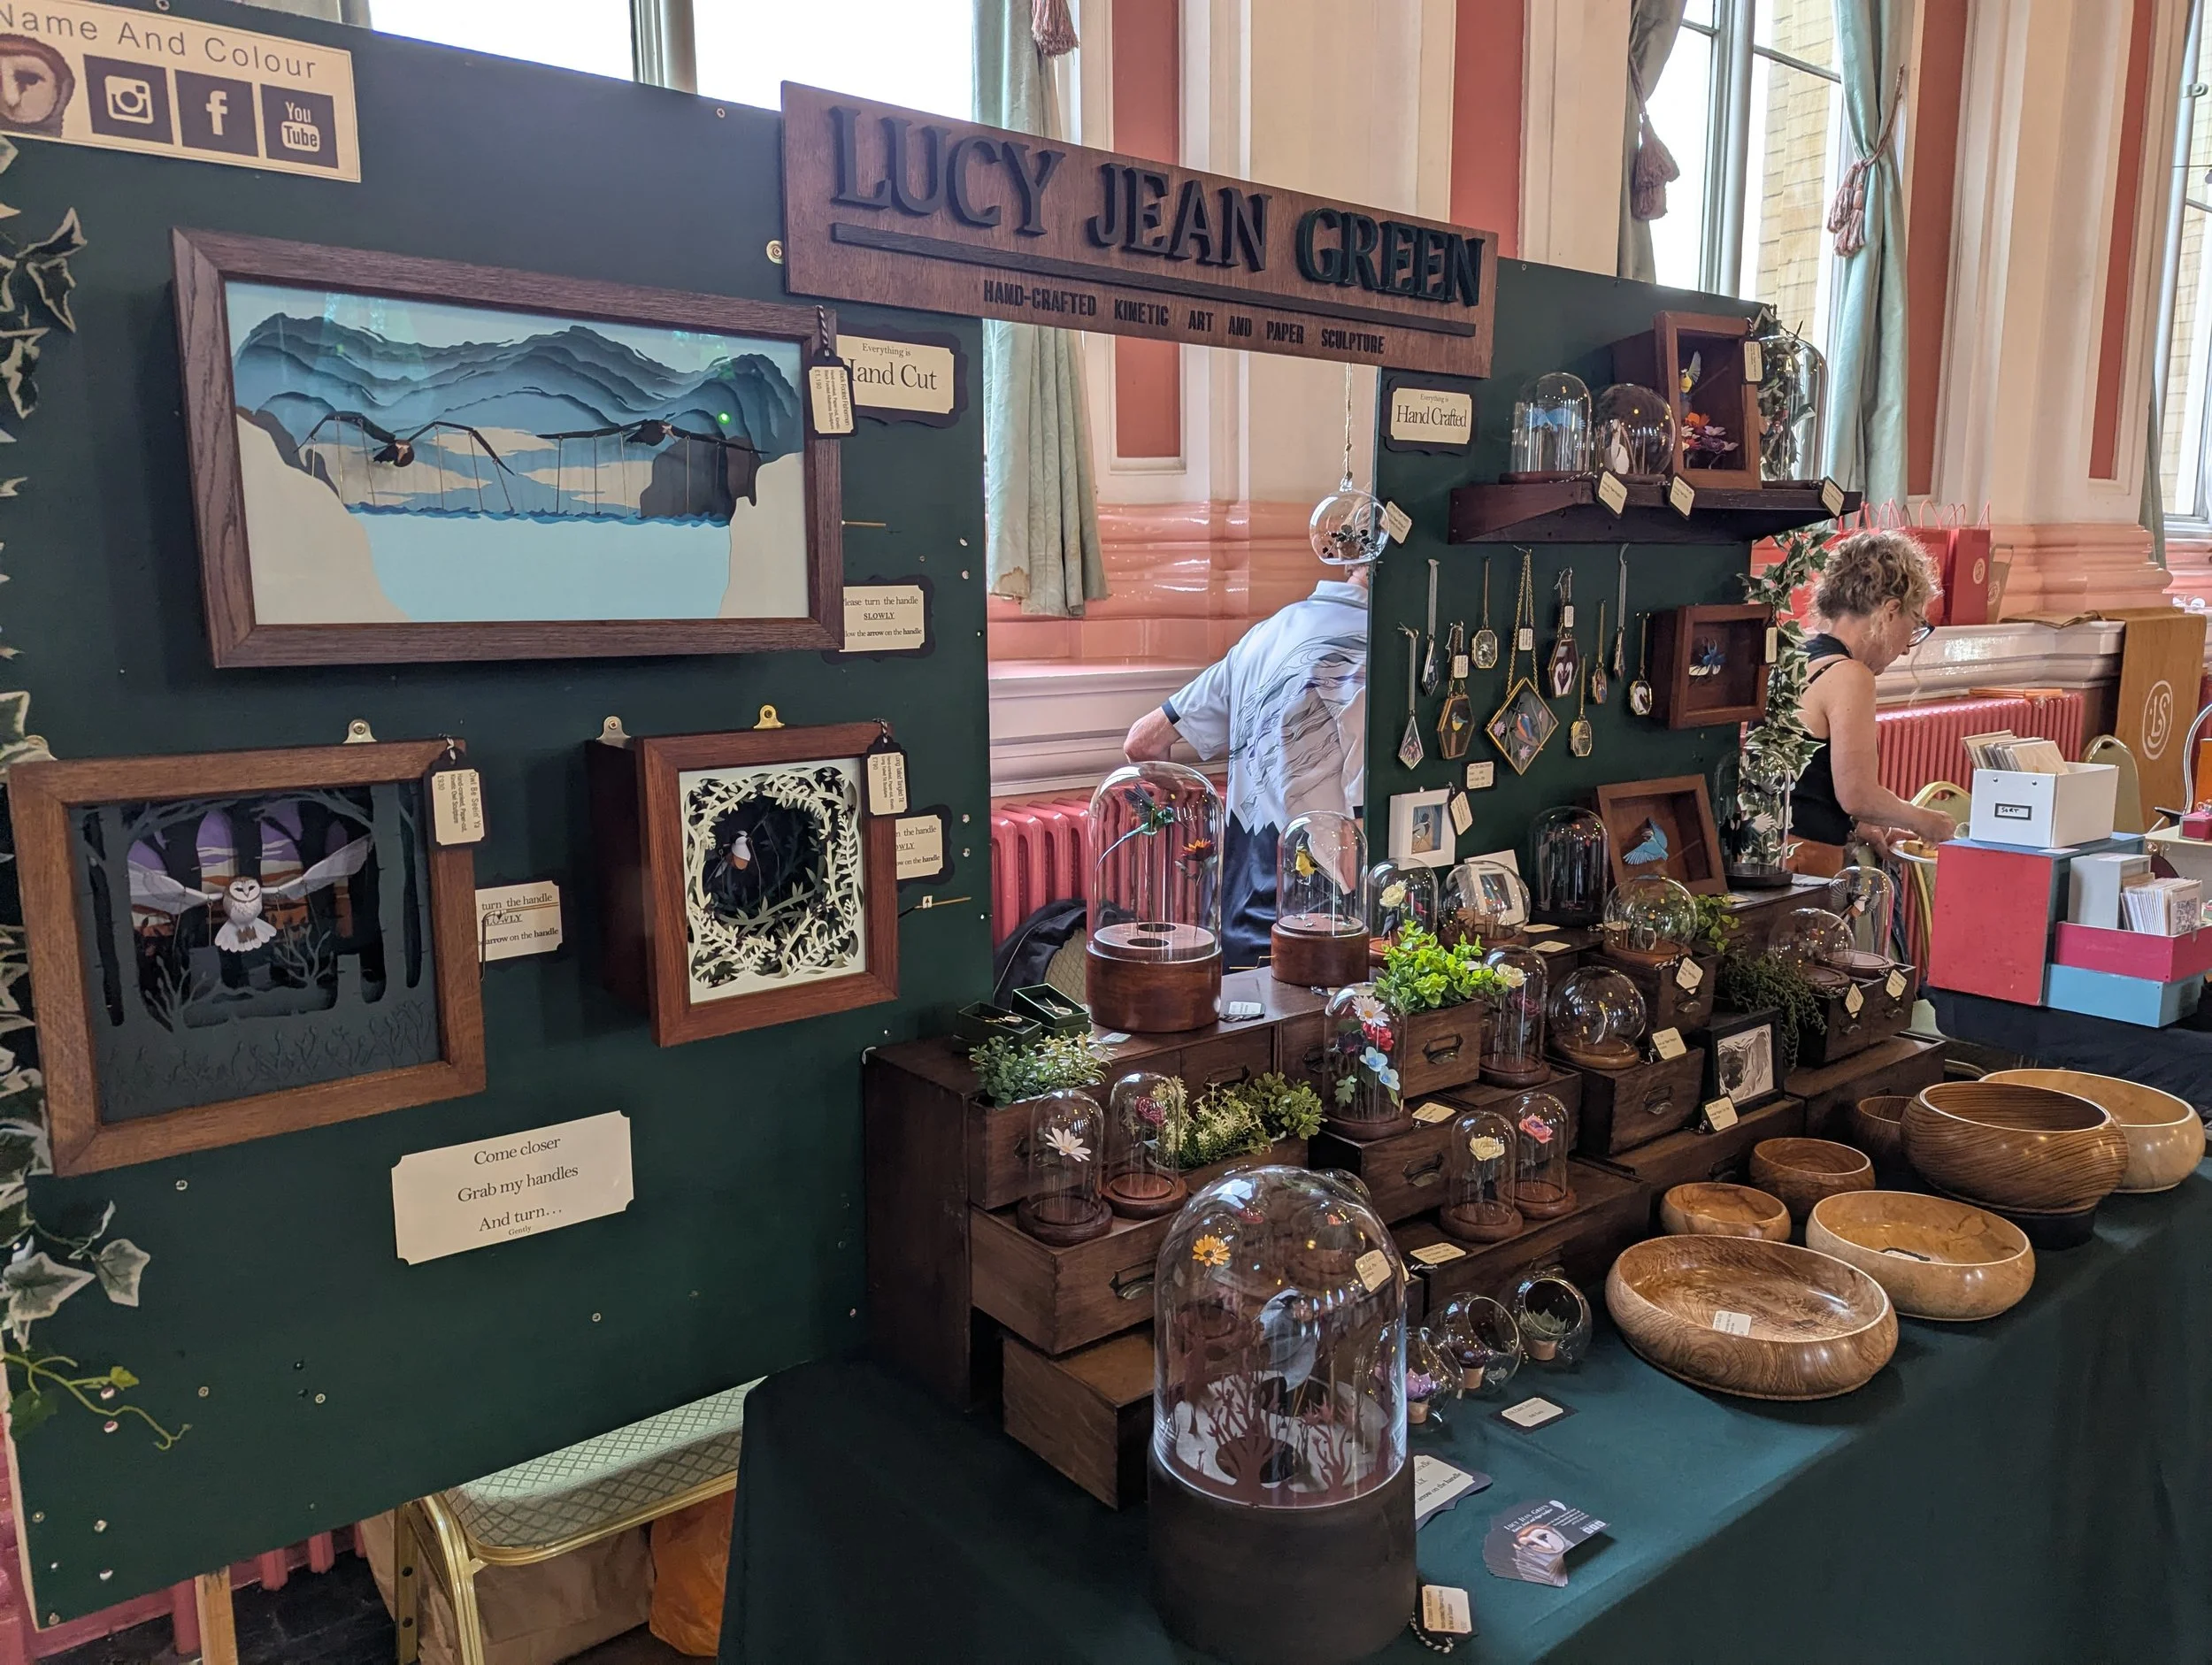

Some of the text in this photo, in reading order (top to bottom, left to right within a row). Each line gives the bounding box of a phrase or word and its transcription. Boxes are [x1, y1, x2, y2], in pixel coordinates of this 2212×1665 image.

[0, 4, 317, 79] Name And Colour
[284, 101, 311, 123] You
[283, 126, 319, 148] Tube
[830, 105, 1486, 307] LUCY JEAN GREEN
[983, 280, 1386, 355] HAND-CRAFTED KINETIC ART AND PAPER SCULPTURE
[862, 342, 911, 358] Everything is
[901, 364, 938, 390] Cut
[1420, 393, 1444, 404] Everything
[1396, 404, 1467, 427] Hand Crafted
[884, 596, 895, 605] the
[895, 596, 918, 605] handle
[864, 611, 895, 620] SLOWLY
[470, 786, 478, 795] Be
[903, 828, 914, 837] the
[915, 825, 937, 835] handle
[922, 854, 941, 863] handle
[481, 893, 553, 910] turn the handle
[486, 936, 509, 945] arrow
[534, 927, 559, 938] handle
[473, 1137, 562, 1166] Come closer
[457, 1165, 580, 1202] Grab my handles
[479, 1211, 511, 1232] And
[508, 1224, 532, 1237] Gently
[1443, 1472, 1462, 1485] handle
